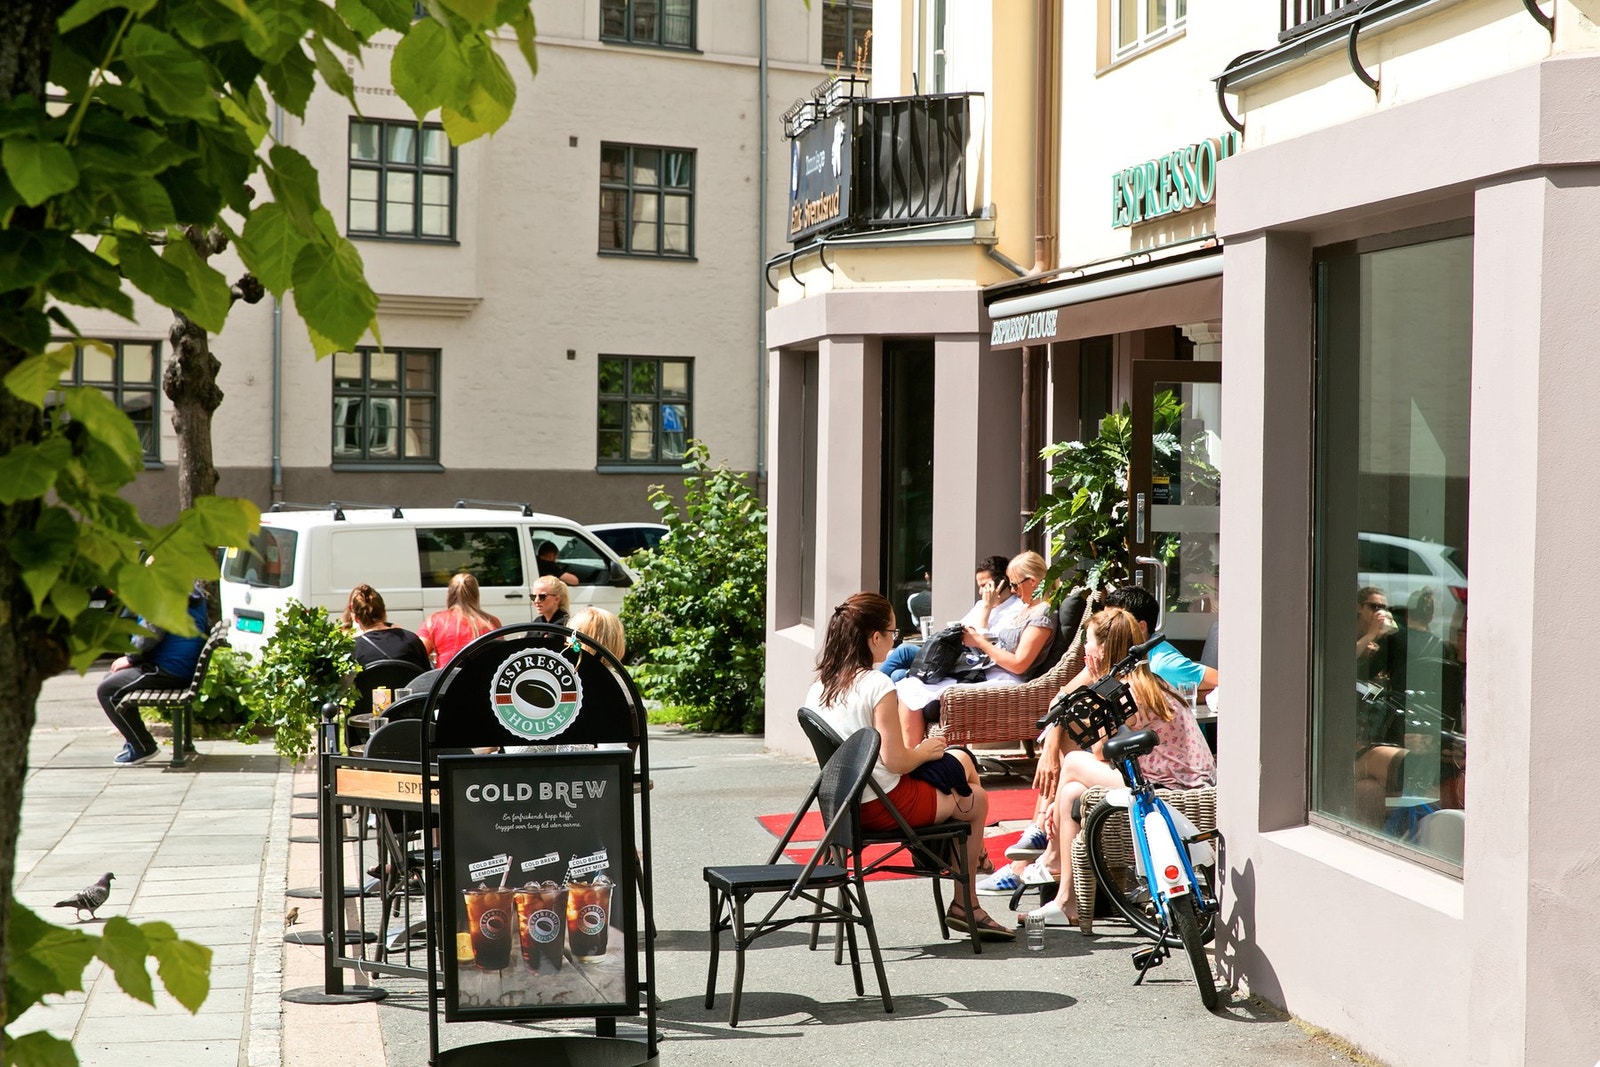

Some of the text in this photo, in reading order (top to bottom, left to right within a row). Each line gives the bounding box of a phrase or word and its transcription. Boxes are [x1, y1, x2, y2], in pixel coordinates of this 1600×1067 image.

[1111, 138, 1217, 229] ESPRESSO
[990, 309, 1059, 346] ESPRESSO HOUSE
[499, 655, 573, 688] ESPRESSO
[509, 711, 566, 733] HOUSE
[465, 780, 607, 808] COLD BREW
[488, 858, 504, 866] BREW
[524, 856, 557, 868] COLD BREW
[572, 855, 604, 866] COLD BREW
[475, 867, 505, 877] LEMONADE
[573, 866, 592, 874] SWEET
